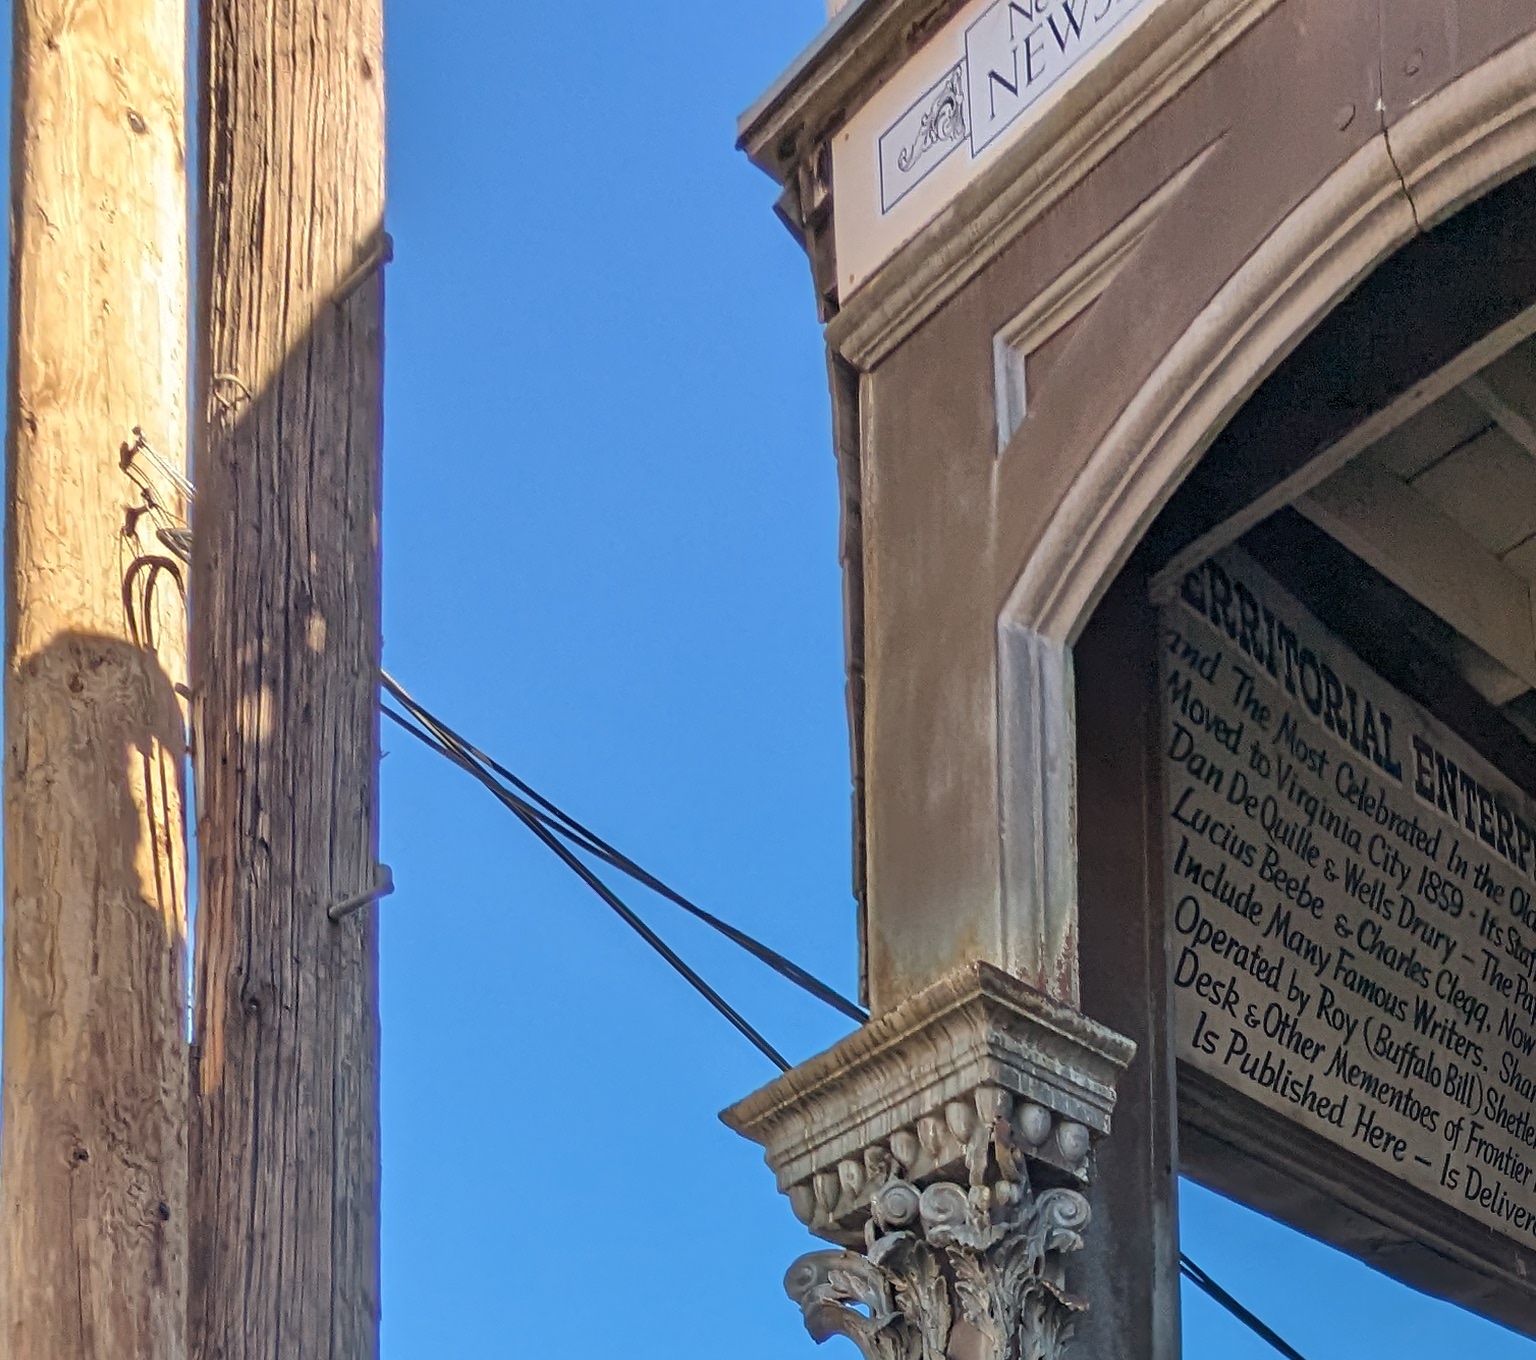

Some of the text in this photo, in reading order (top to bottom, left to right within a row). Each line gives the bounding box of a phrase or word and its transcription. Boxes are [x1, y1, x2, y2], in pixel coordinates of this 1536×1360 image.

[1167, 629, 1222, 686] and
[1231, 663, 1271, 732] The
[1271, 710, 1330, 780] Most
[1334, 760, 1442, 862] Celebrated
[1445, 837, 1469, 881] In
[1472, 861, 1506, 906] the
[1167, 670, 1245, 756] Moved
[1247, 739, 1272, 780] to
[1275, 753, 1363, 855] Virginia
[1366, 832, 1412, 900] City
[1416, 864, 1465, 919] 1859
[1167, 721, 1225, 794] Dan
[1343, 856, 1395, 922] Wells
[1396, 893, 1457, 966] Drury
[1480, 946, 1513, 999] The
[1170, 785, 1258, 869] Lucius
[1257, 842, 1325, 921] Beebe
[1355, 917, 1432, 990] Charles
[1496, 1006, 1536, 1057] Now
[1173, 835, 1264, 927] Include
[1260, 902, 1332, 978] Many
[1332, 945, 1409, 1023] Famous
[1174, 894, 1285, 993] Operated
[1285, 967, 1311, 1018] by
[1315, 982, 1359, 1047] Roy
[1173, 945, 1240, 1019] Desk
[1261, 1001, 1326, 1064] Other
[1321, 1044, 1440, 1133] Mementoes
[1442, 1115, 1468, 1154] of
[1461, 1116, 1533, 1186] Frontier
[1190, 1009, 1221, 1055] Is
[1223, 1027, 1349, 1128] Published
[1351, 1101, 1408, 1163] Here
[1438, 1151, 1461, 1191] Is
